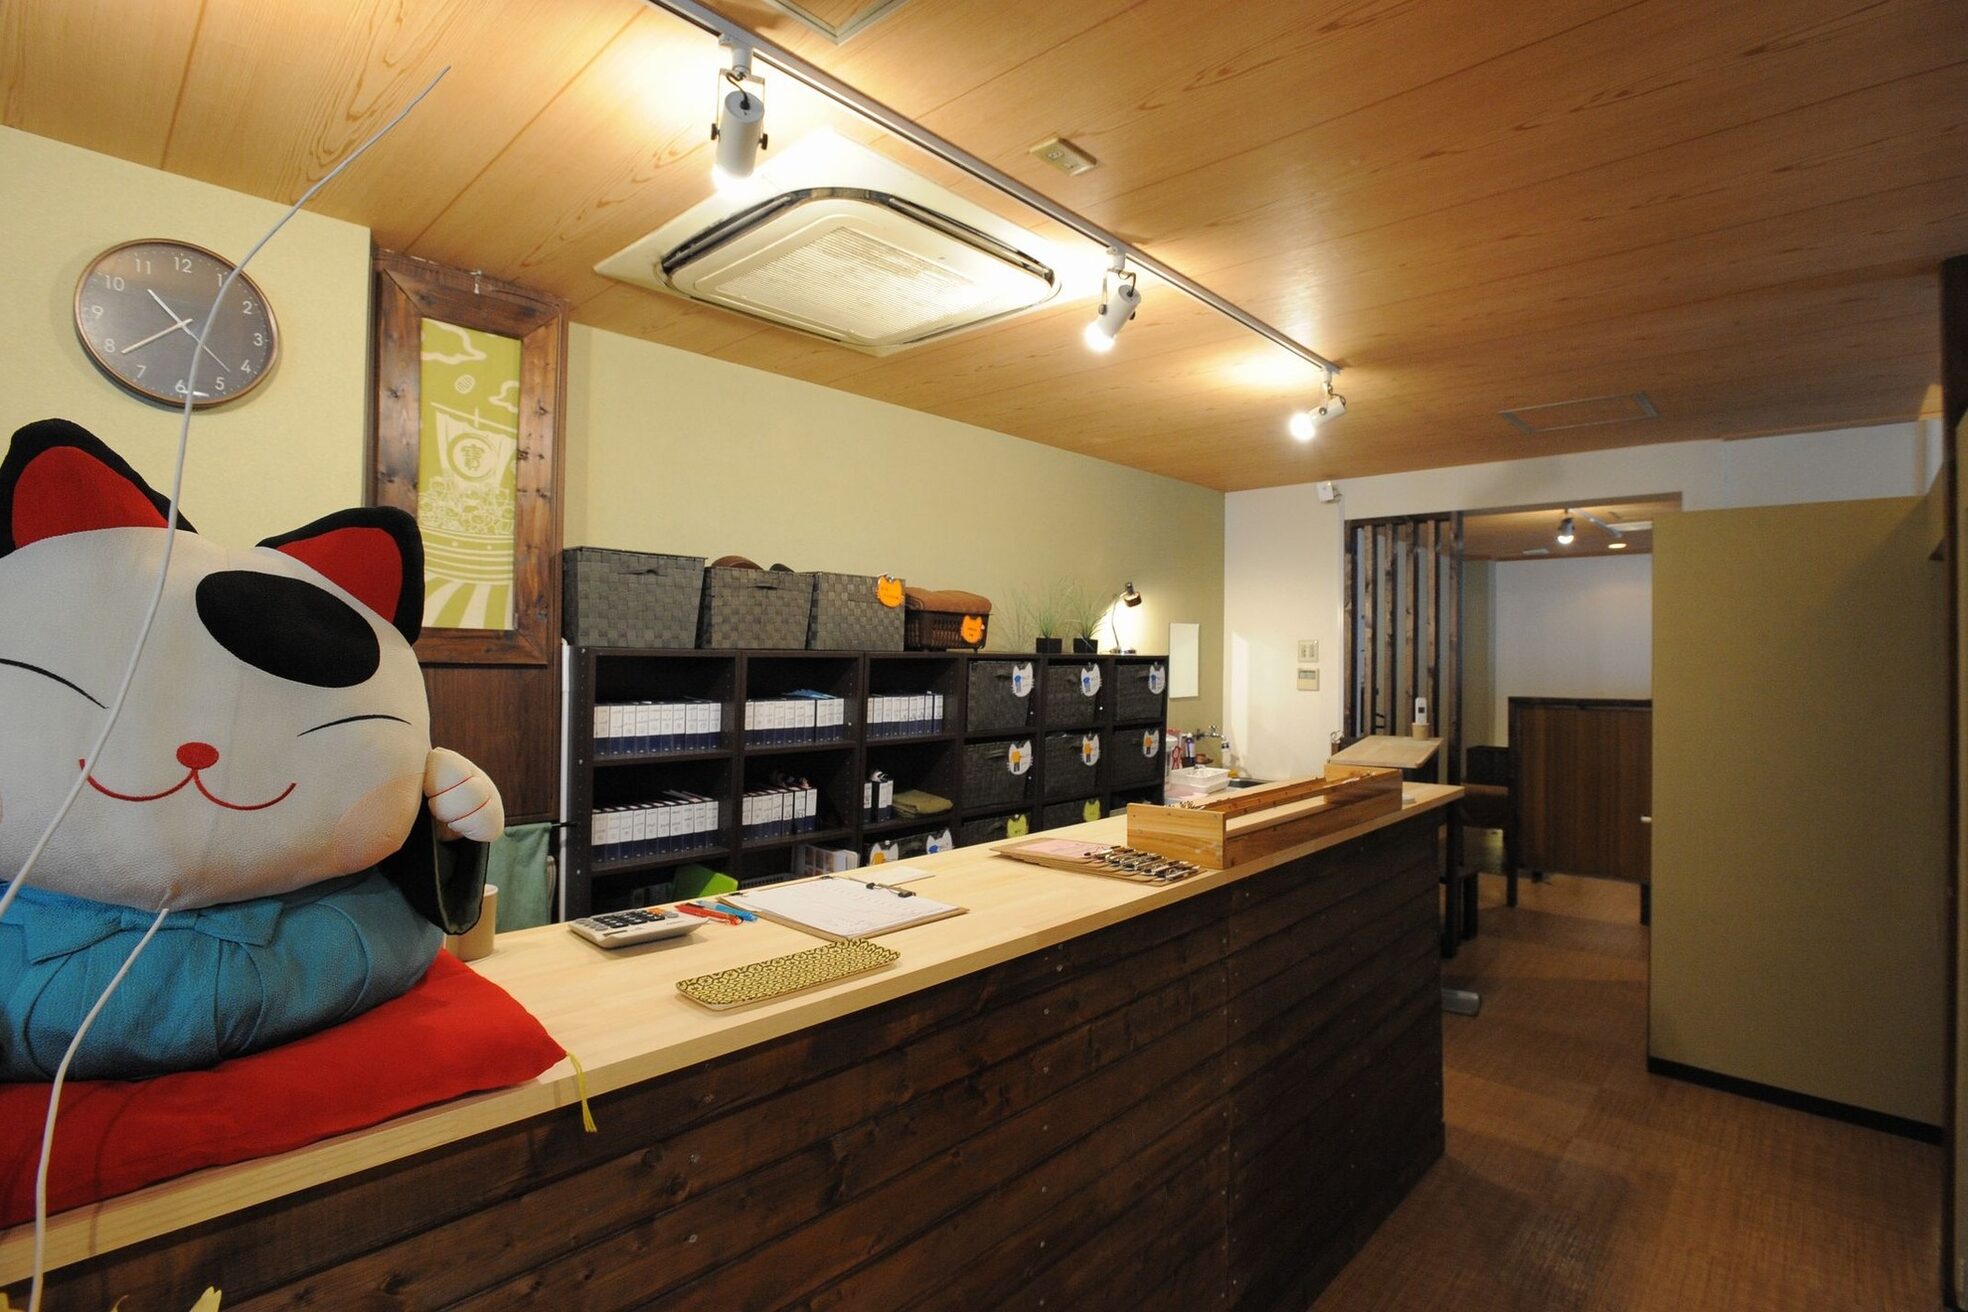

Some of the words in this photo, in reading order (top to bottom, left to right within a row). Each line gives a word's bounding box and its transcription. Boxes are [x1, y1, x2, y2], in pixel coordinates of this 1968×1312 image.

[136, 258, 151, 274] 11
[174, 257, 192, 273] 12
[105, 275, 125, 291] 10
[217, 274, 223, 287] 1
[92, 306, 103, 318] 9
[243, 301, 252, 314] 2
[104, 339, 115, 353] 8
[253, 332, 263, 346] 3
[136, 365, 147, 378] 7
[240, 360, 251, 374] 4
[175, 379, 186, 393] 6
[215, 376, 225, 390] 5
